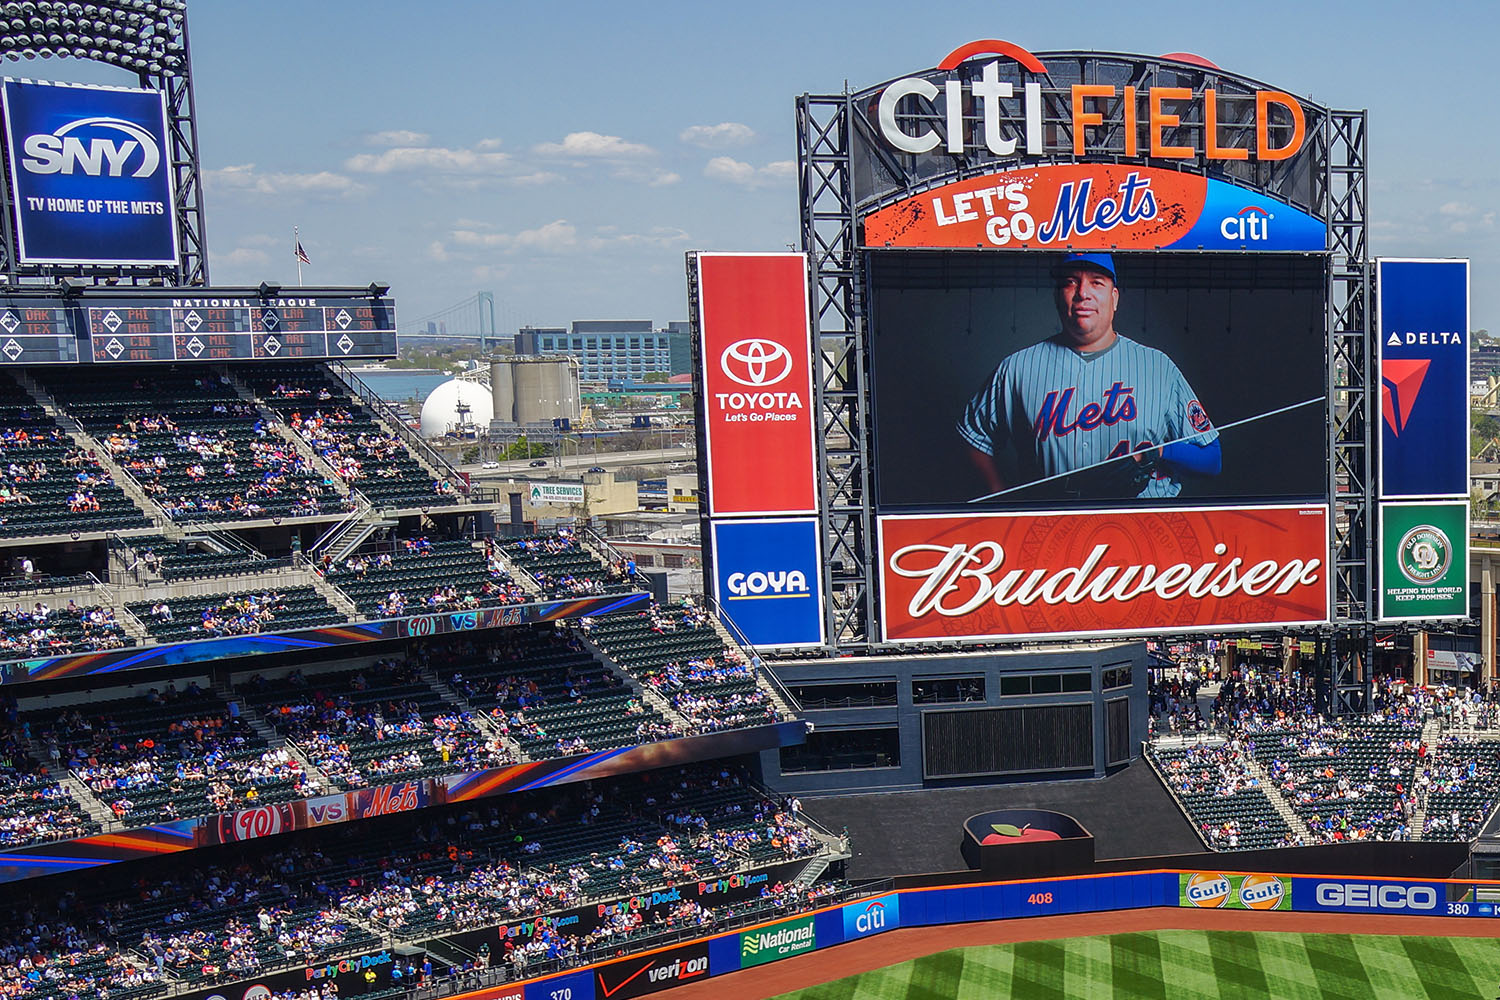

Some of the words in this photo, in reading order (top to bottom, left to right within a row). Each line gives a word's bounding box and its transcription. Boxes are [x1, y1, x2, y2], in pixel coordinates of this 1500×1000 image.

[878, 59, 1043, 156] citi
[1070, 84, 1306, 162] FIELD
[22, 134, 140, 177] SNY
[27, 197, 45, 211] TV
[47, 198, 85, 213] HOME
[88, 199, 103, 213] OF
[105, 200, 129, 214] THE
[131, 201, 164, 215] METS
[931, 181, 1030, 228] LET'S
[1037, 171, 1157, 244] Mets
[985, 215, 1035, 247] GO
[1221, 208, 1269, 241] citi
[173, 299, 250, 308] NATIONAL
[260, 299, 316, 307] LEAGUE
[1406, 332, 1462, 345] DELTA
[715, 392, 803, 410] TOYOTA
[1035, 382, 1138, 441] Mets
[725, 412, 748, 422] Let's
[750, 412, 763, 422] Go
[765, 412, 797, 422] Places
[542, 485, 555, 495] TREE
[556, 486, 582, 496] SERVICES
[889, 541, 1322, 619] Budweiser
[310, 802, 343, 824] VS
[363, 782, 419, 818] Mets
[1027, 892, 1054, 905] 408
[1189, 881, 1229, 902] Gulf
[1242, 882, 1281, 905] Gulf
[1316, 883, 1437, 910] GEICO
[856, 905, 885, 934] citi
[1447, 903, 1469, 915] 380
[778, 945, 790, 954] Car
[791, 940, 812, 951] Rental
[648, 955, 709, 983] verizon
